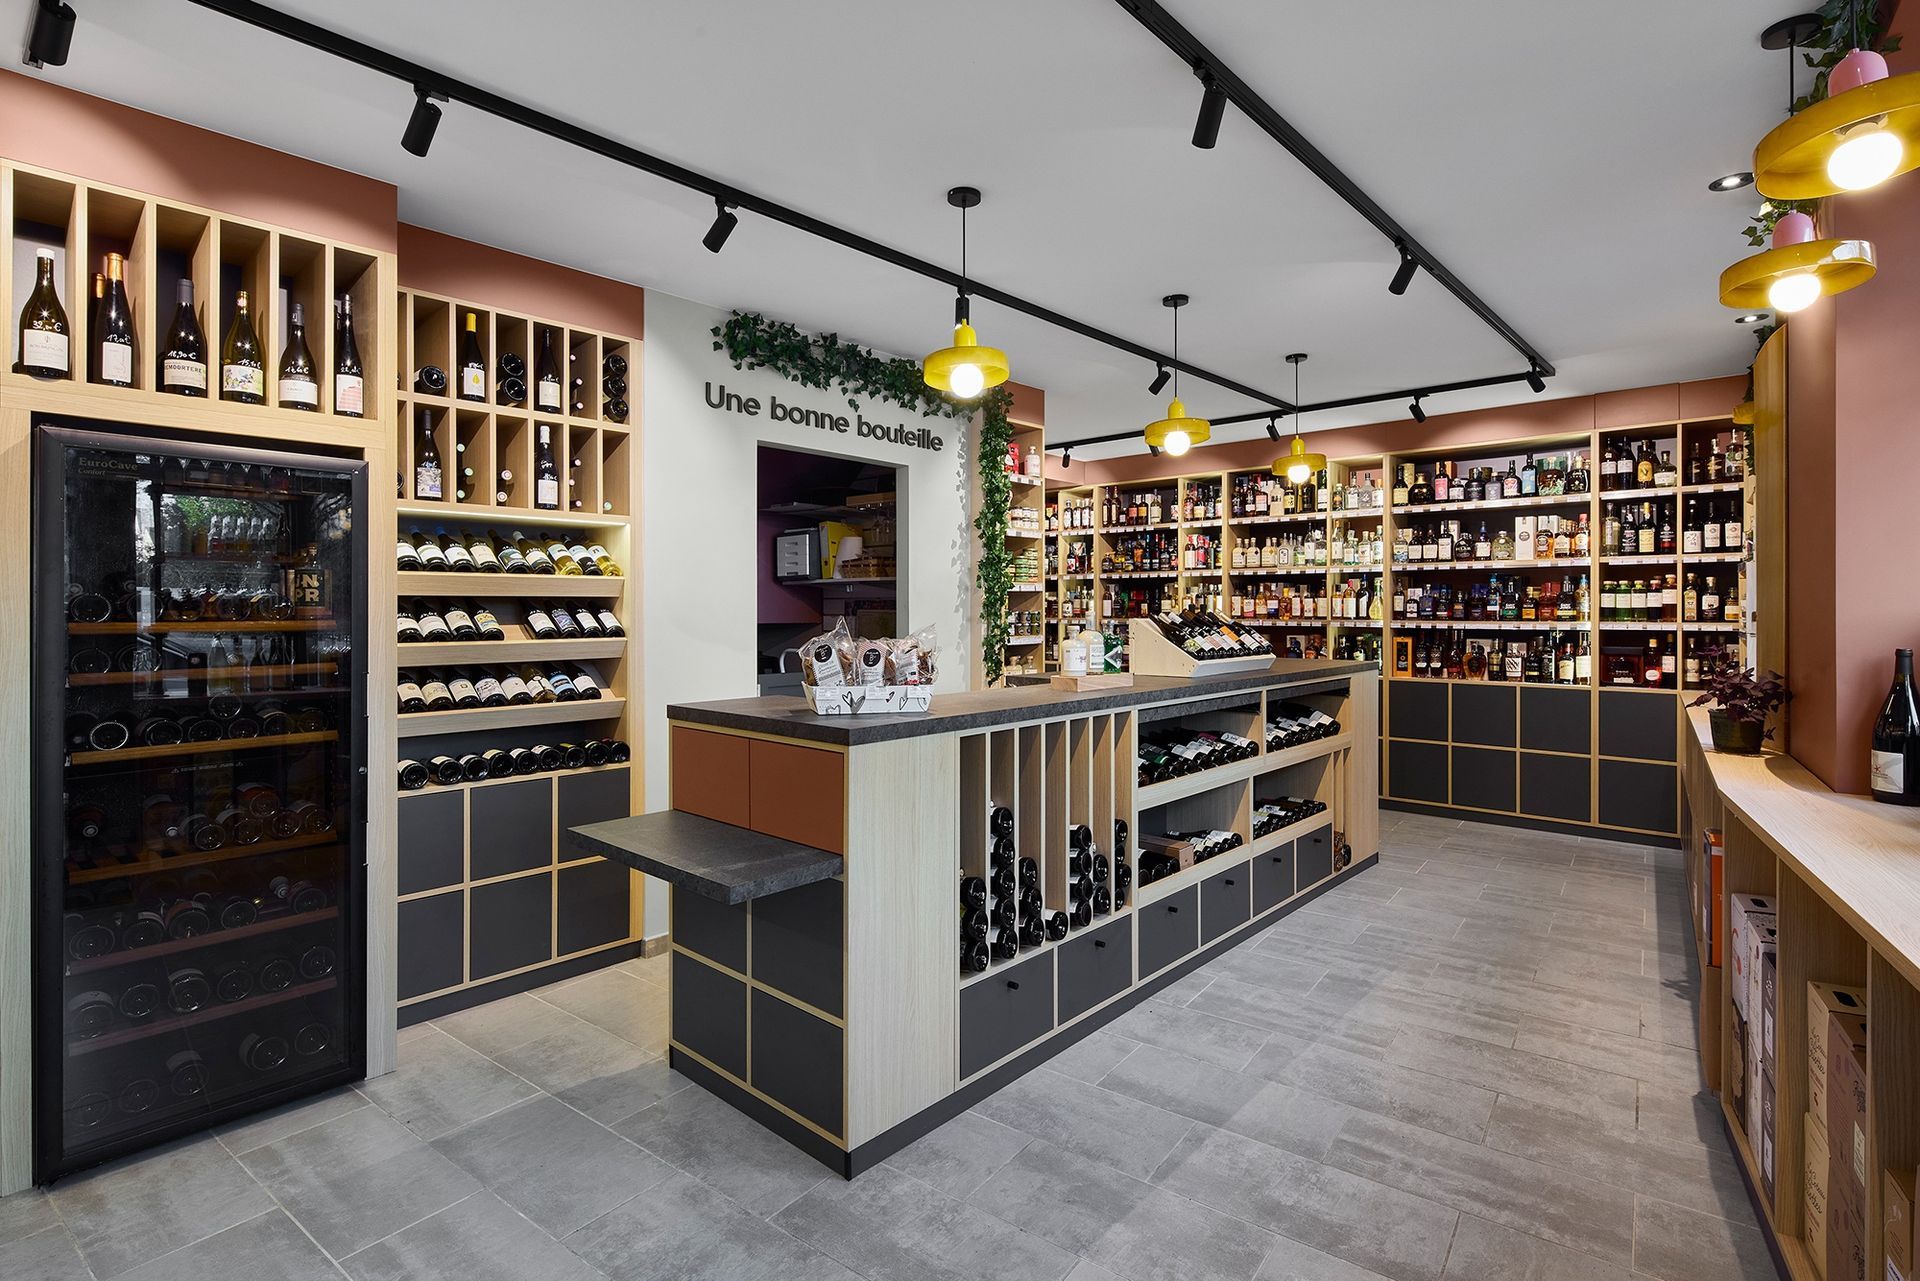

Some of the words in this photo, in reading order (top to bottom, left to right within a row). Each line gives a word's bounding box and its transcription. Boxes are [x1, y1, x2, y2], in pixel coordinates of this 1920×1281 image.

[705, 382, 761, 416] Une
[770, 396, 849, 433] bonne
[857, 415, 944, 452] bouteille
[79, 457, 138, 471] EuroCave
